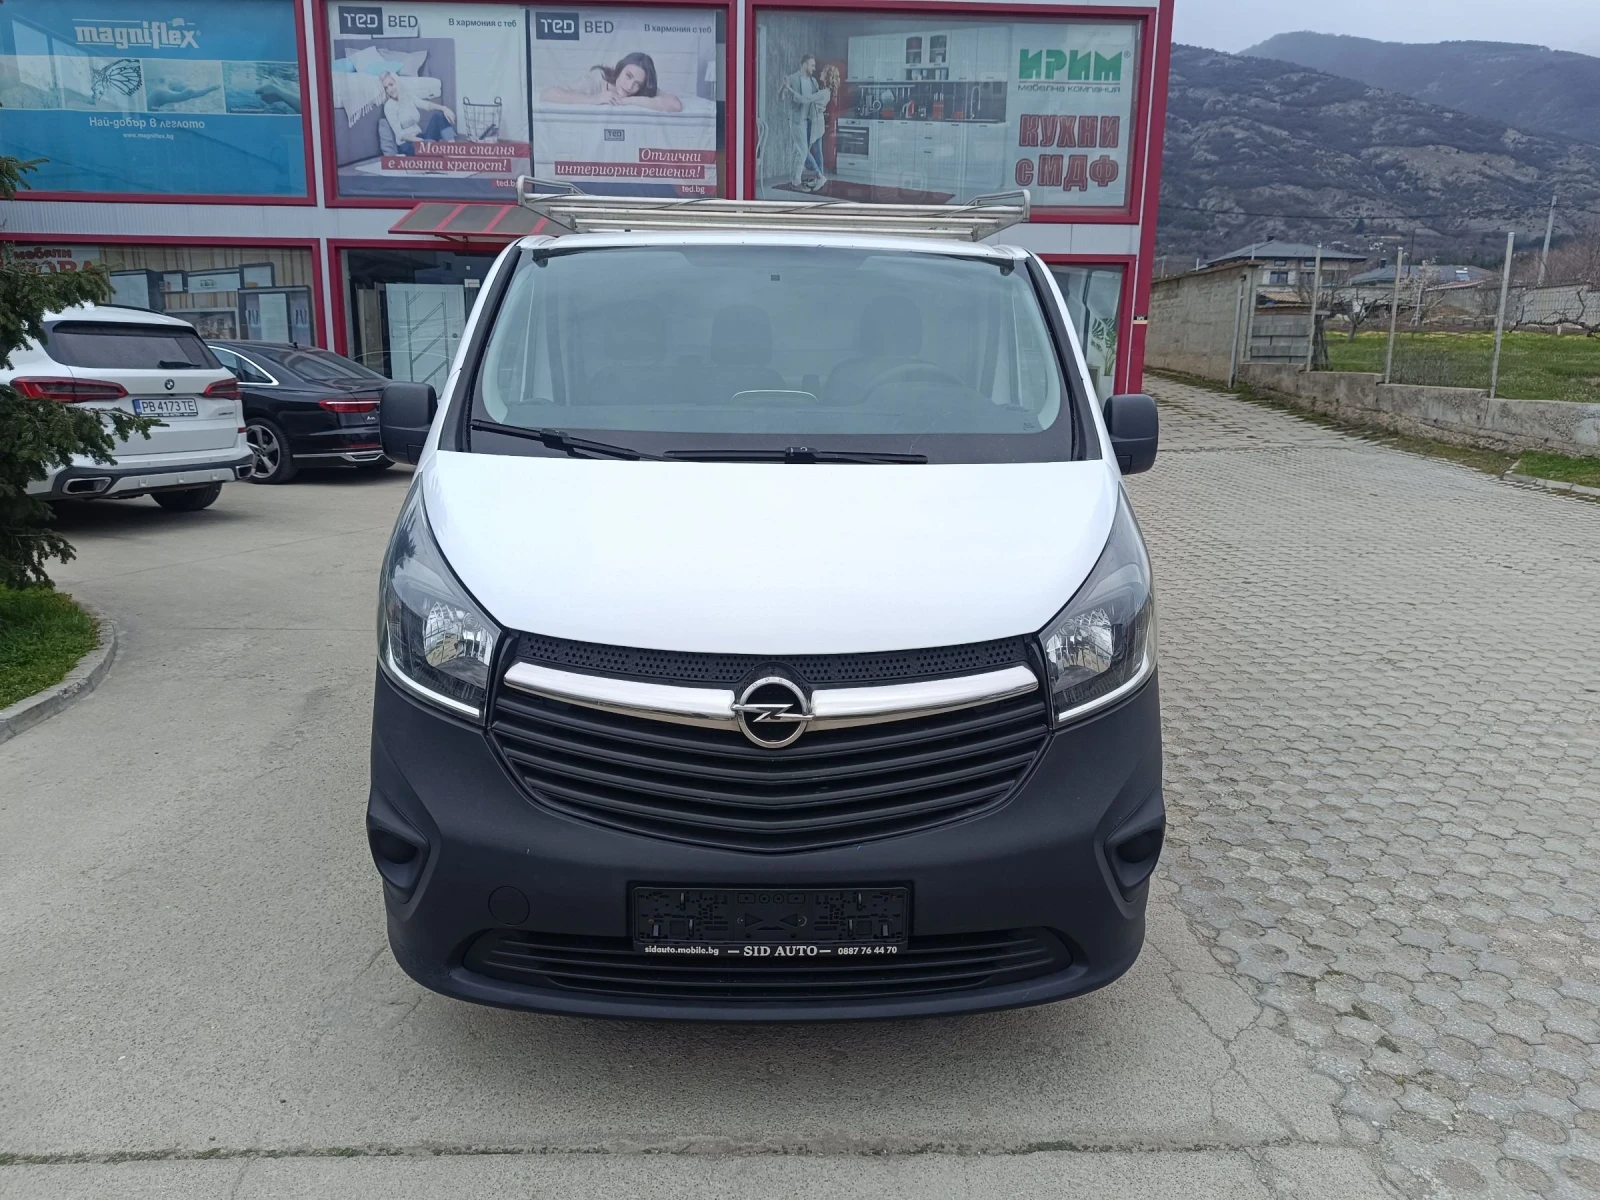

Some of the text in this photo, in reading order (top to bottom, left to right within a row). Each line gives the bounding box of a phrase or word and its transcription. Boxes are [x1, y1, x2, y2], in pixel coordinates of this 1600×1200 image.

[388, 15, 418, 28] BED
[448, 18, 455, 26] В
[456, 20, 496, 28] хармония
[584, 21, 614, 34] BED
[74, 20, 200, 49] magniflex
[644, 23, 651, 32] В
[651, 25, 691, 34] хармония
[698, 26, 712, 34] теб
[1018, 48, 1123, 81] ИРИМ
[1067, 85, 1121, 93] компания
[89, 117, 205, 129] Най-добър в леглото
[1018, 113, 1120, 148] КУХНИ
[418, 141, 515, 156] Моята спалня
[641, 148, 701, 162] Отлични
[388, 159, 507, 173] е моята крепост!
[556, 165, 701, 179] интериорни решения!
[1015, 154, 1119, 192] с МДФ
[681, 185, 705, 194] ted.bg
[141, 401, 156, 412] PB
[157, 401, 181, 412] 4173
[181, 400, 195, 411] TE
[644, 945, 719, 956] sidauto.mobile.bg
[743, 945, 771, 957] SID
[774, 945, 818, 957] AUTO
[837, 947, 859, 955] 0887
[873, 946, 885, 954] 44
[886, 946, 898, 954] 70
